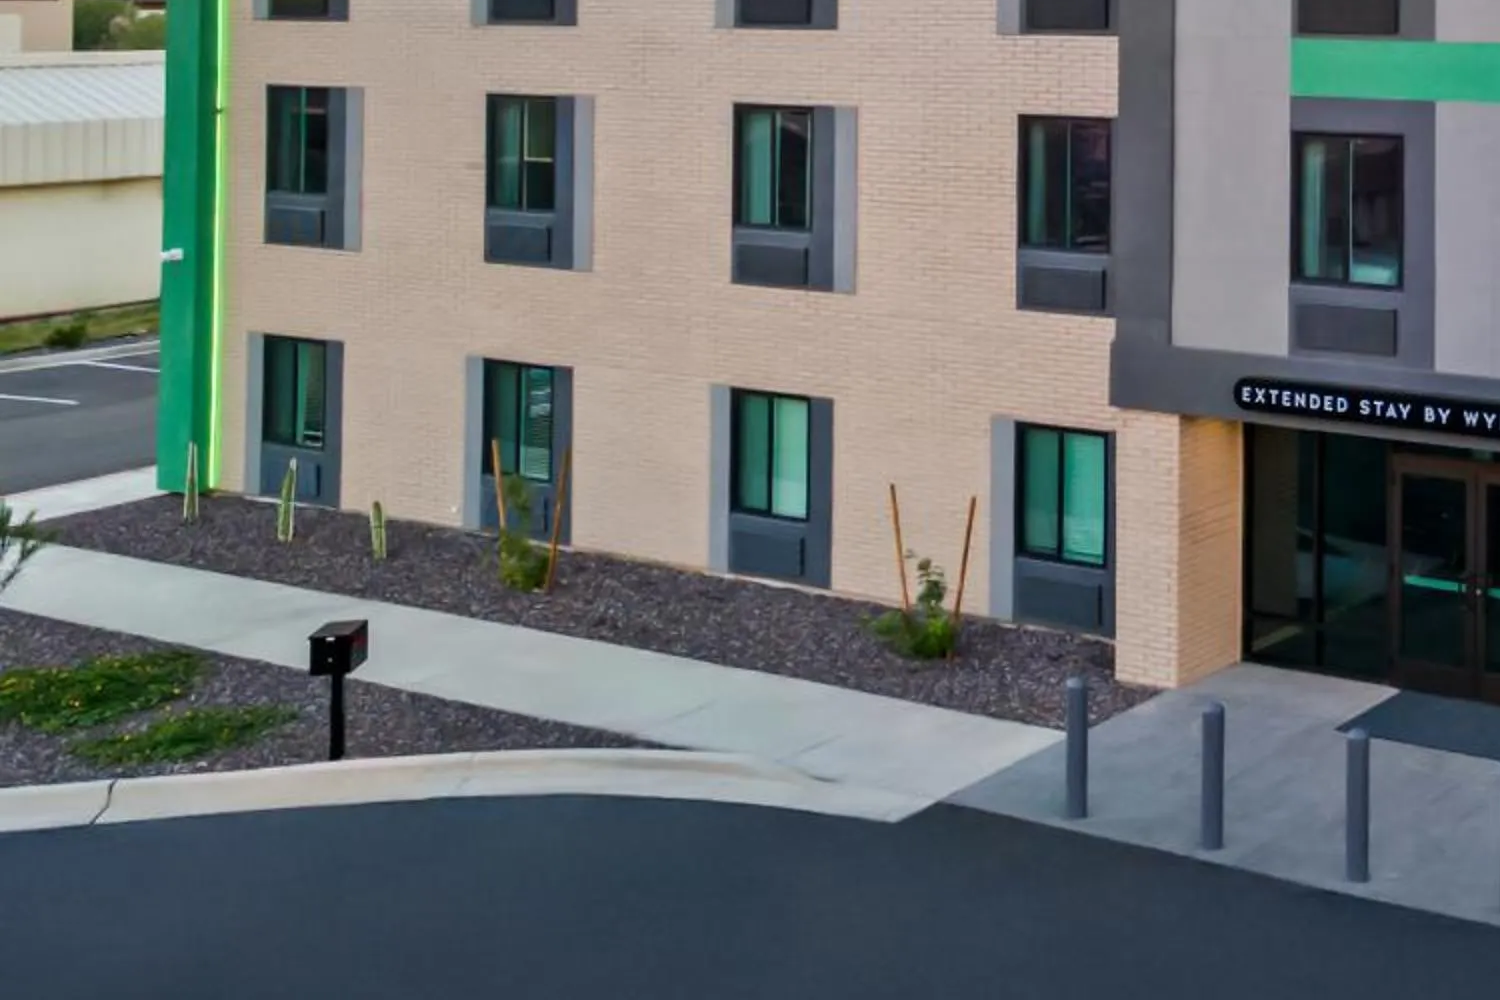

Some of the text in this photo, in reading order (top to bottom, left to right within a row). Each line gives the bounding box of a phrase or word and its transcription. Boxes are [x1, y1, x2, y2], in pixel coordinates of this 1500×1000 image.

[1241, 386, 1348, 413] EXTENDED
[1359, 399, 1411, 421] STAY
[1423, 406, 1450, 425] BY
